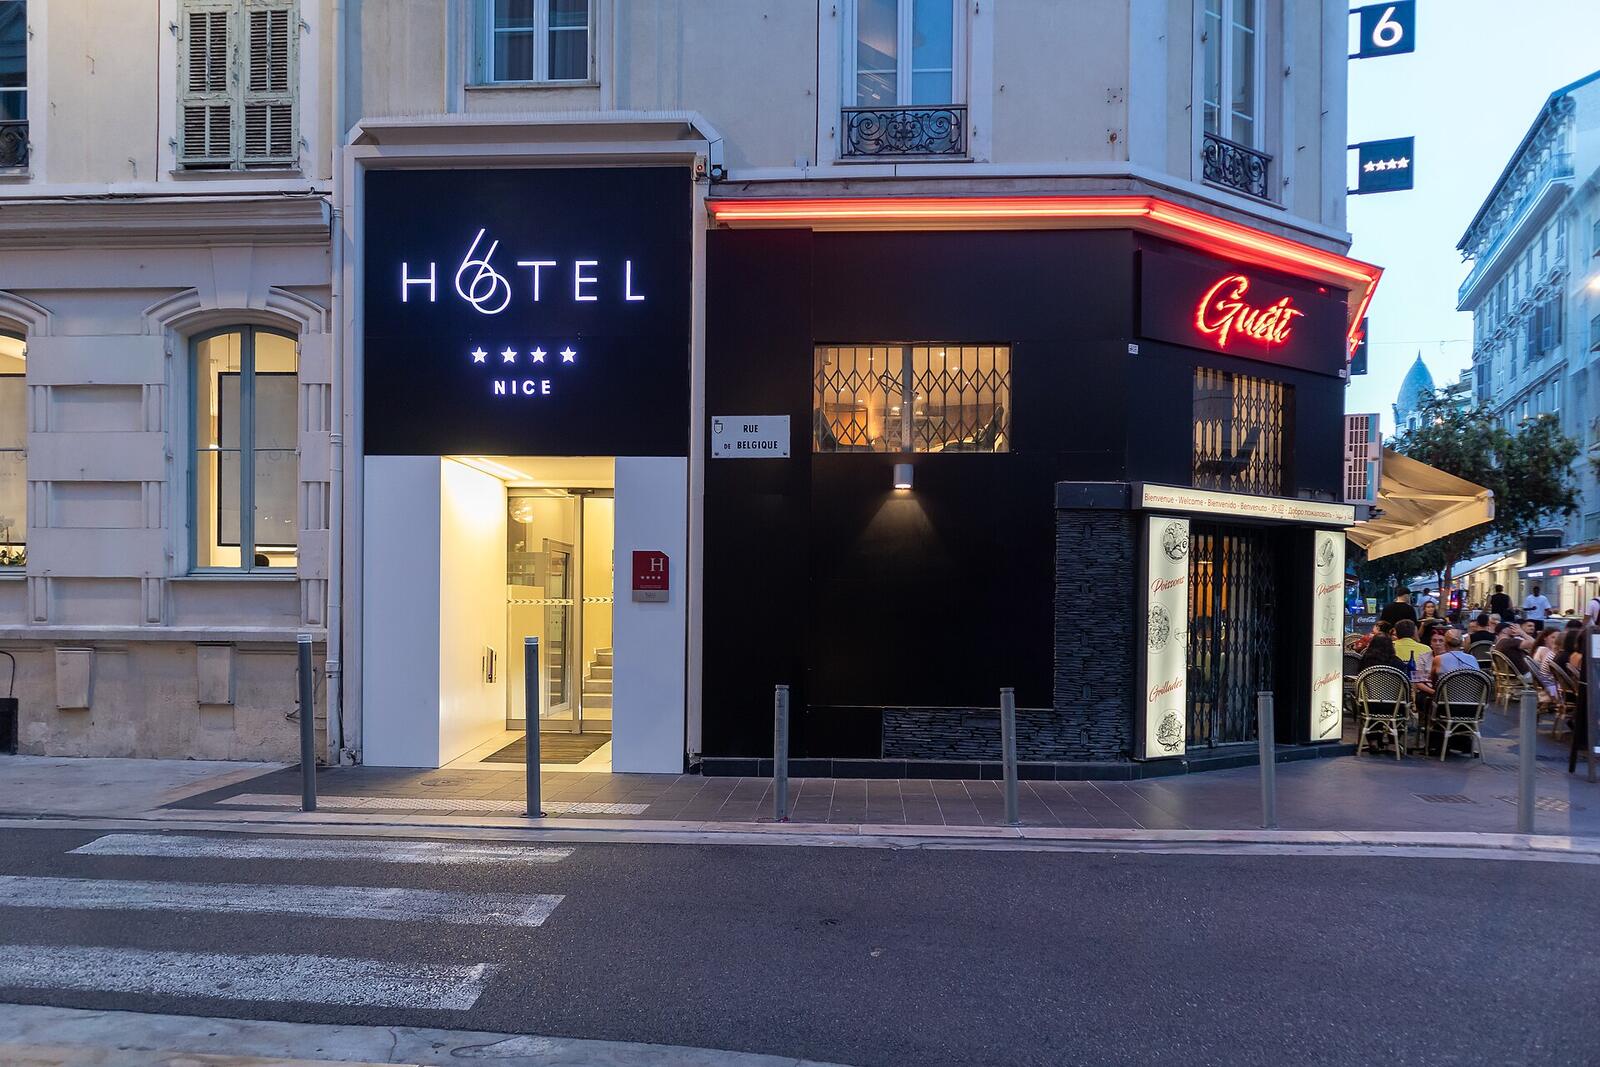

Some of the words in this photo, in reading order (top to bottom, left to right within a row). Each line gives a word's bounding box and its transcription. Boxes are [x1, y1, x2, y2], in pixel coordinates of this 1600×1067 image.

[1372, 6, 1404, 48] 6
[1196, 275, 1304, 348] Gusti
[494, 380, 551, 395] NICE
[743, 424, 759, 433] RUE
[736, 440, 778, 450] BELGIQUE
[1144, 493, 1174, 504] Bienvenue
[1178, 496, 1203, 506] Welcome
[1207, 498, 1237, 509] Bienvenido
[651, 557, 665, 572] H
